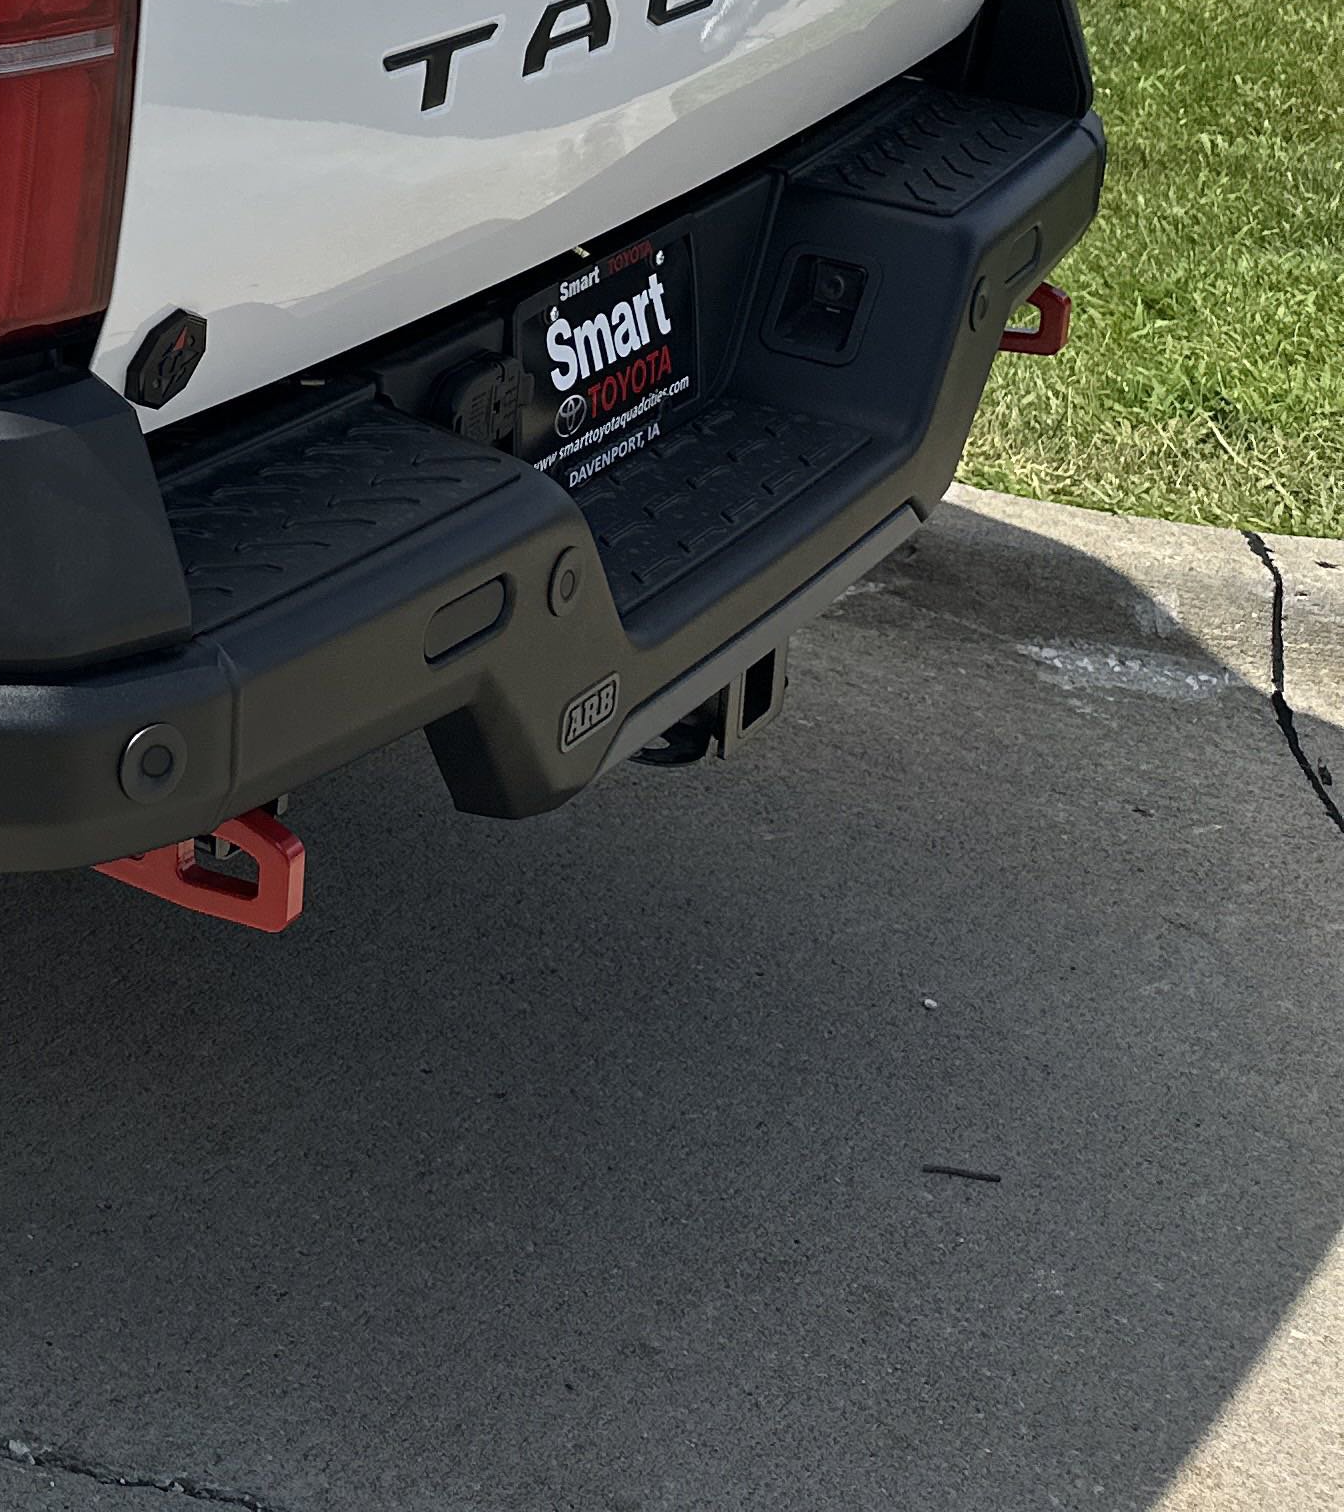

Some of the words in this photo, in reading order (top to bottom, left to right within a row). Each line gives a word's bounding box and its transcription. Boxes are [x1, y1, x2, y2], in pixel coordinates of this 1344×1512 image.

[559, 265, 600, 302] Smart
[608, 240, 654, 275] TOYOTA
[546, 273, 672, 391] Smart
[588, 345, 673, 419] TOYOTA
[533, 375, 690, 473] wwsmarttoyotaquadcities.com
[568, 431, 646, 489] DAVENPORT,
[647, 422, 661, 442] IA
[564, 680, 616, 745] ARB
